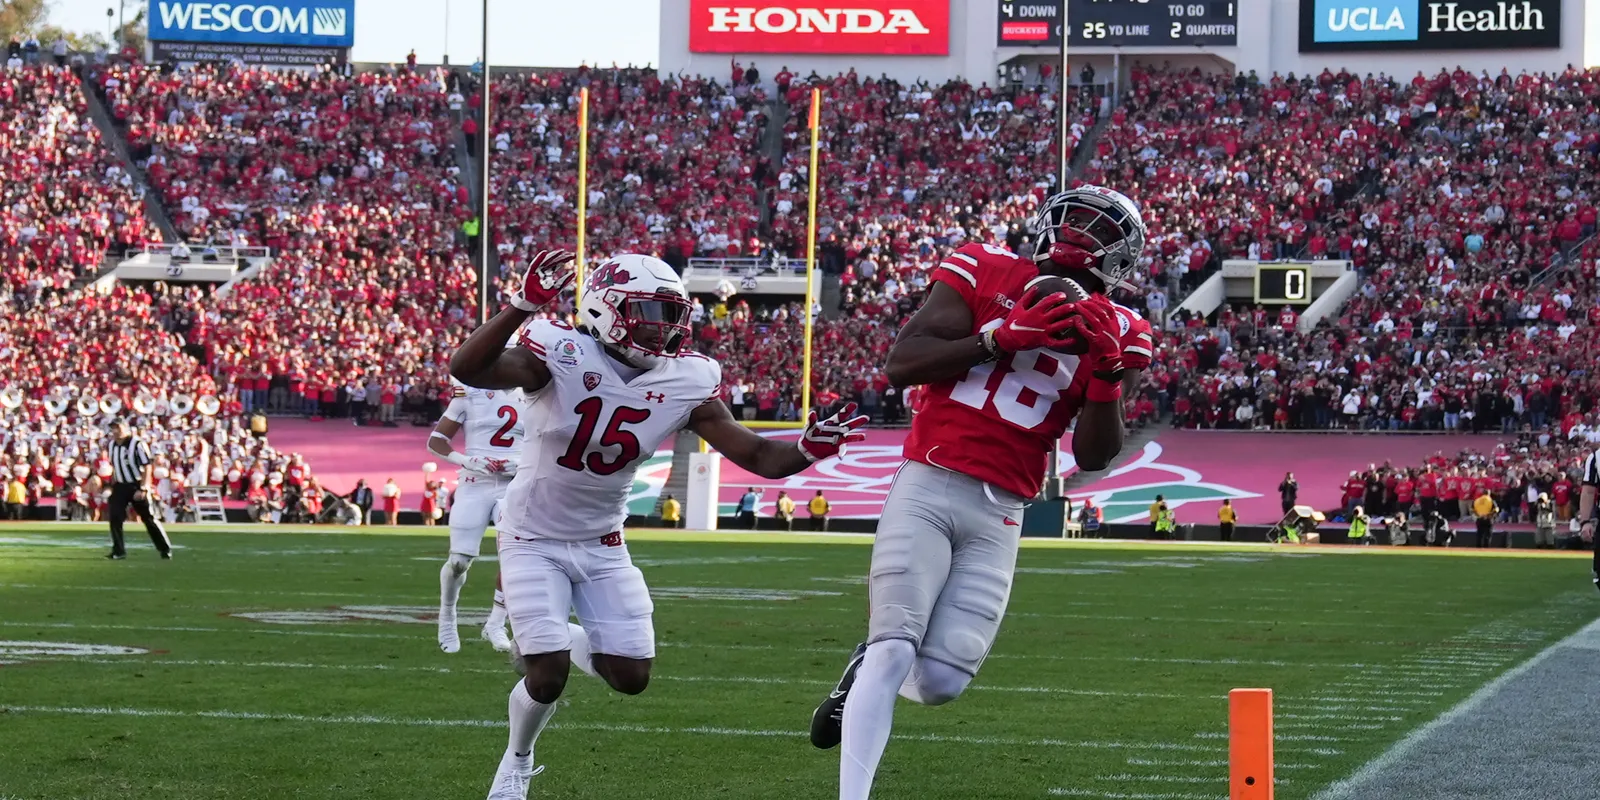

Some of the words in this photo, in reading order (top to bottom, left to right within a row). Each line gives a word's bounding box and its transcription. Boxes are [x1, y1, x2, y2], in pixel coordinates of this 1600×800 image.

[158, 2, 308, 34] WESCOM
[707, 7, 930, 34] HONDA
[1002, 4, 1013, 18] 4
[1019, 5, 1057, 18] DOWN
[1168, 4, 1184, 17] TO
[1187, 4, 1205, 17] GO
[1227, 2, 1233, 17] 1
[1327, 5, 1405, 32] UCLA
[1428, 1, 1545, 33] Health
[1083, 22, 1106, 39] 25
[1108, 24, 1123, 36] YD
[1126, 24, 1150, 36] LINE
[1170, 22, 1182, 39] 2
[1186, 24, 1236, 36] QUARTER
[1285, 269, 1304, 300] 0
[949, 318, 1080, 430] 18
[489, 404, 518, 448] 2
[556, 396, 651, 476] 15
